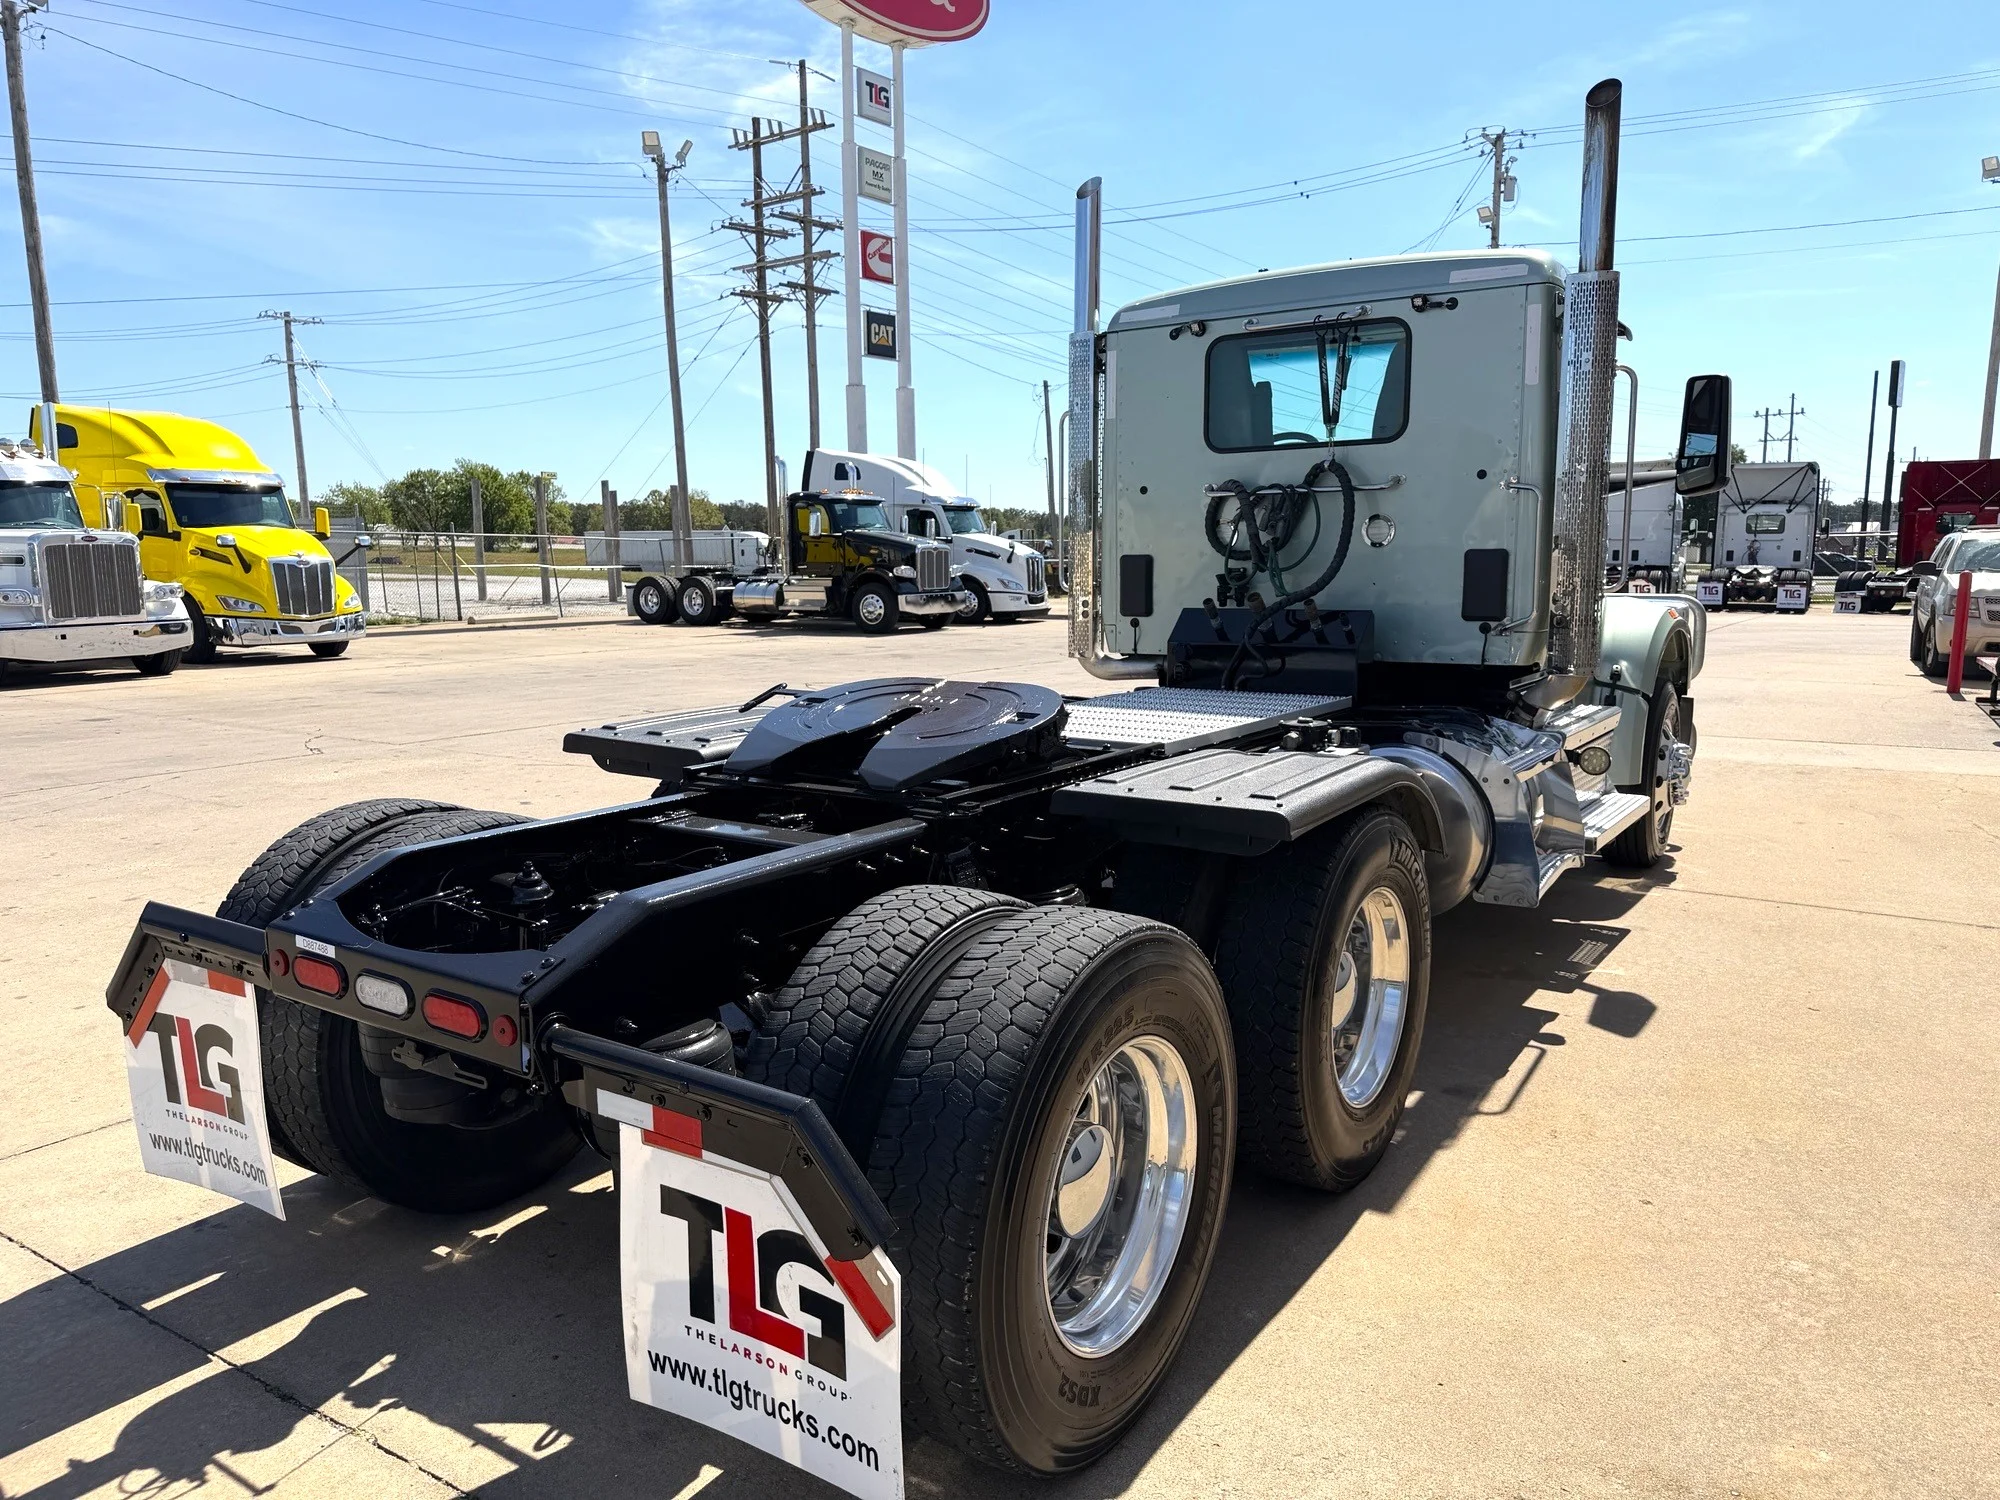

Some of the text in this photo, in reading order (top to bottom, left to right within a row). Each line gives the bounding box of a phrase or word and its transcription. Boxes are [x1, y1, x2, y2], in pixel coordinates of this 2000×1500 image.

[865, 80, 890, 109] TLG
[872, 170, 884, 180] MX
[867, 239, 889, 260] Cummins
[871, 322, 894, 347] CAT
[1633, 584, 1651, 593] TLG
[1702, 586, 1718, 595] TLG
[1782, 589, 1802, 599] TLG
[1838, 601, 1856, 611] TLG
[147, 1011, 246, 1126] TLG
[223, 1125, 249, 1142] GROUP
[149, 1130, 268, 1188] www.tlgtrucks.com
[660, 1184, 848, 1382] TLG
[795, 1369, 849, 1401] GROUP
[1058, 1372, 1101, 1408] XDS2
[647, 1349, 880, 1472] www.tlgtrucks.com
